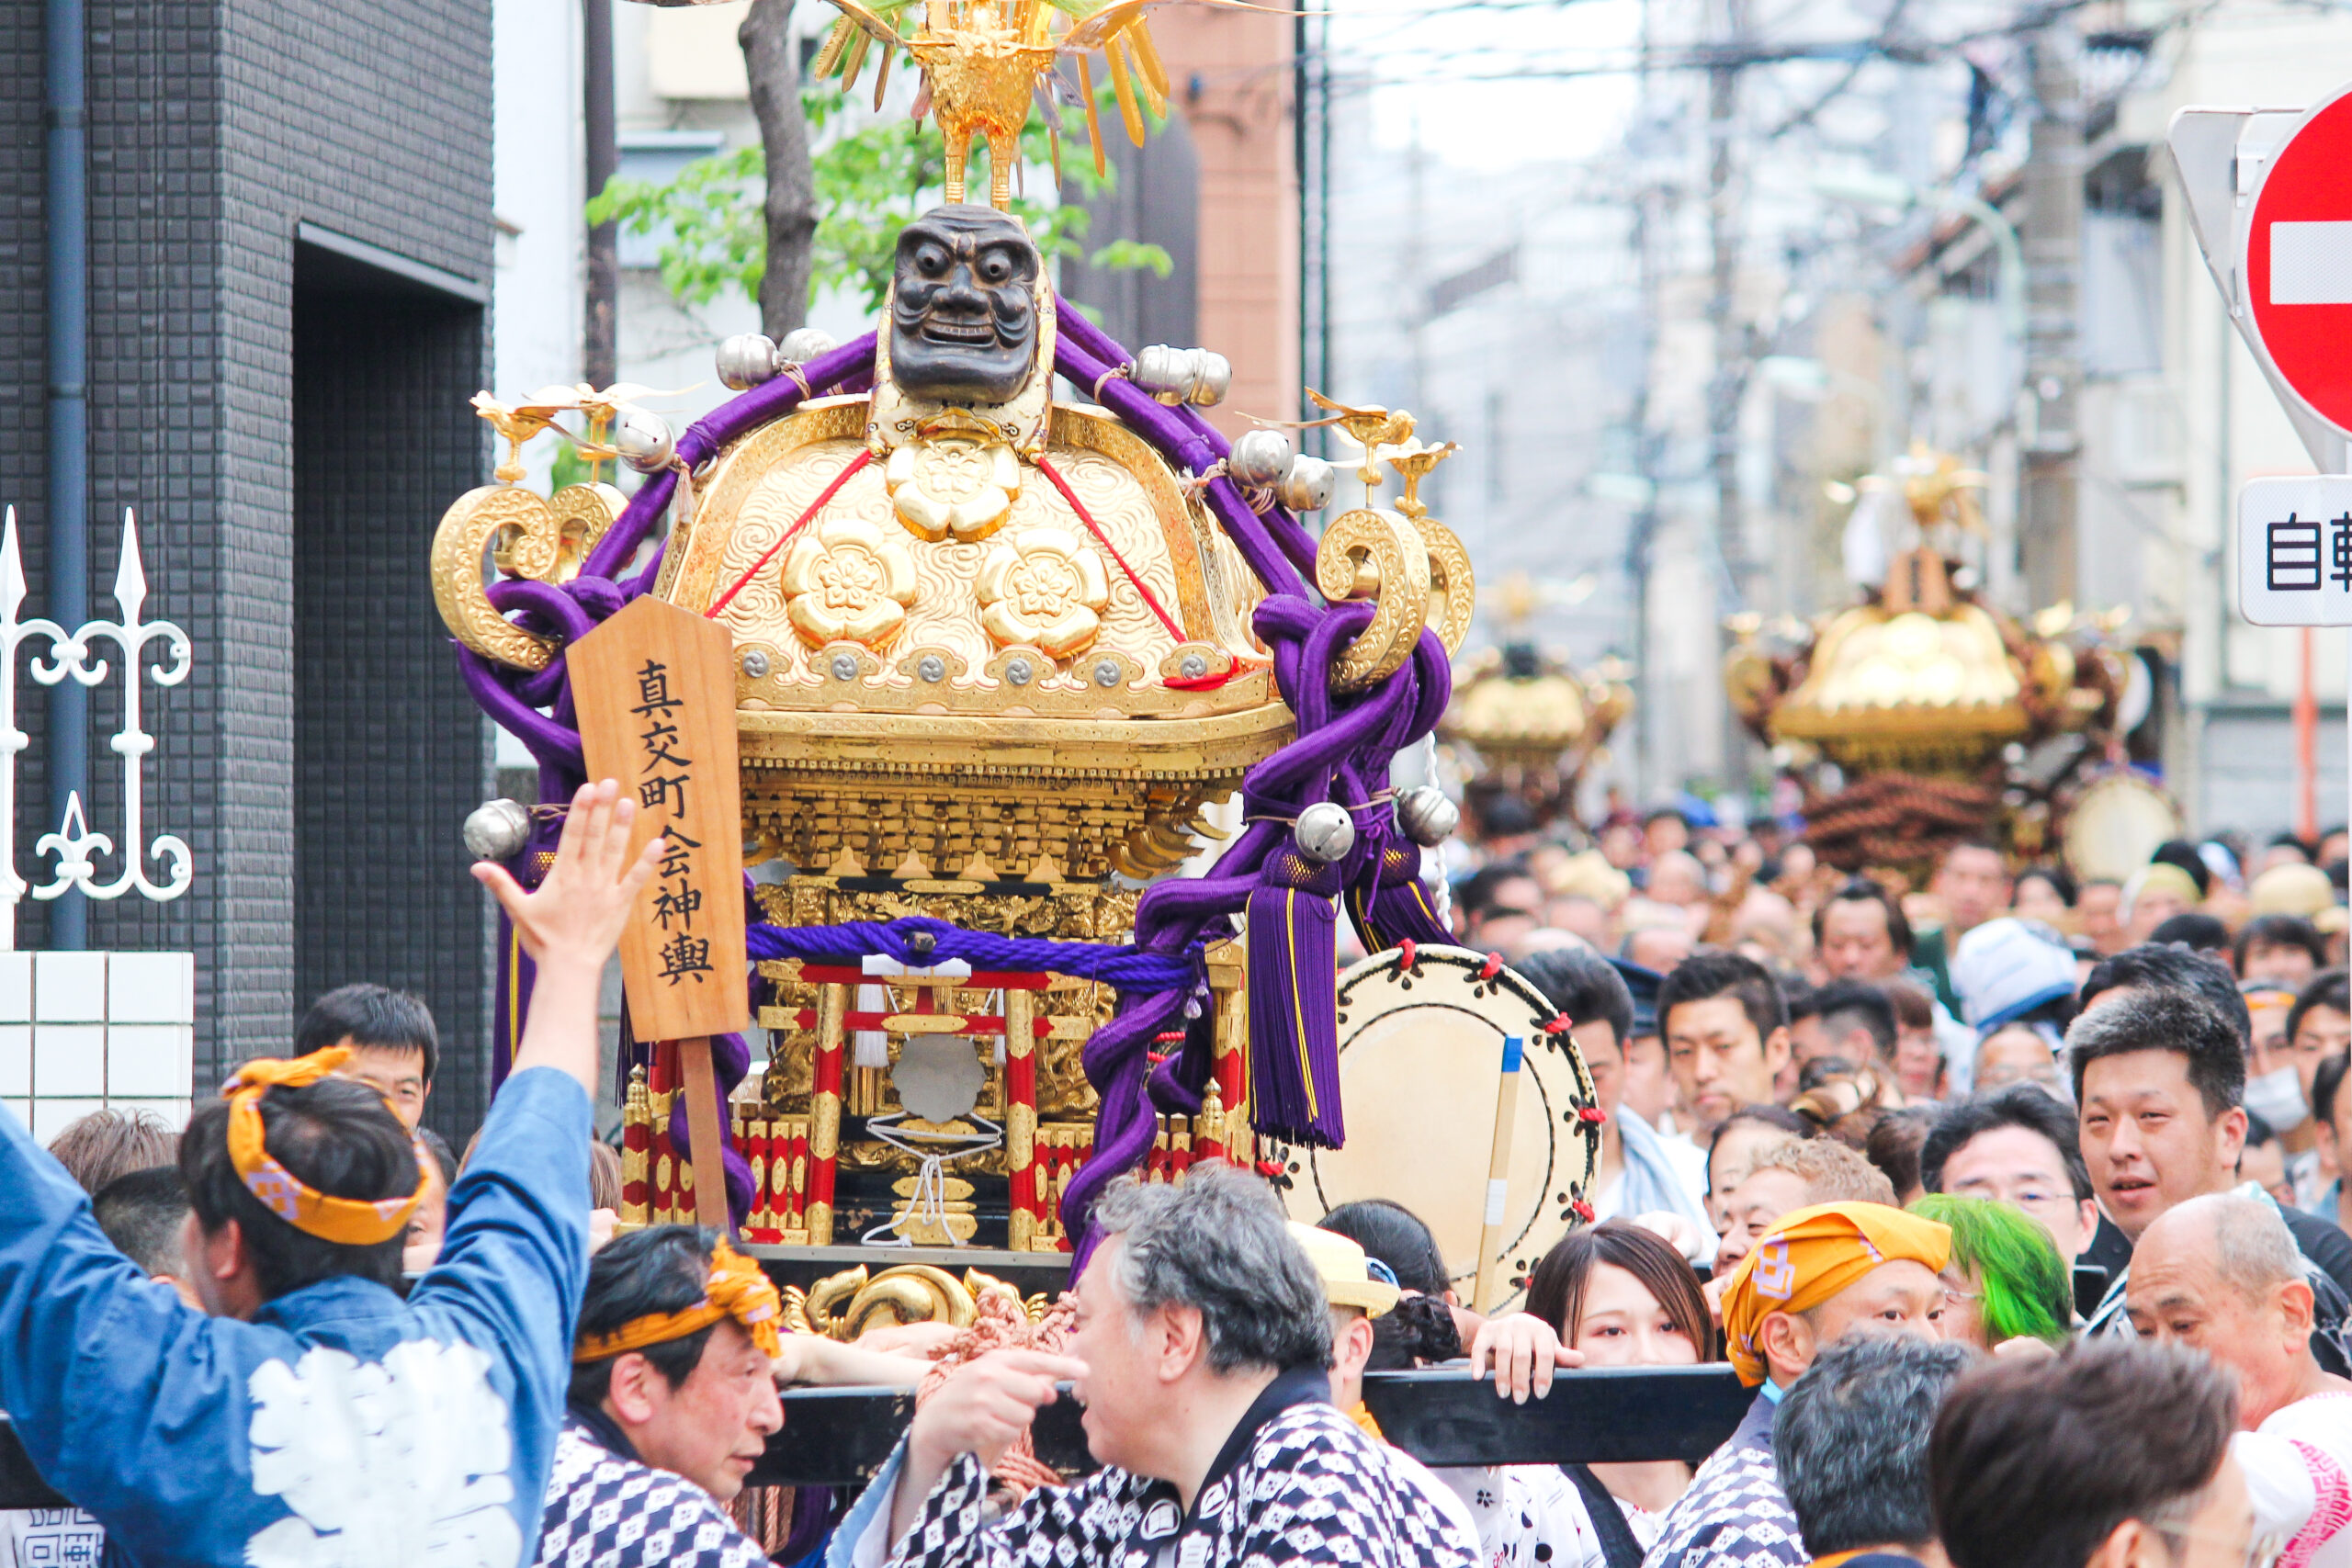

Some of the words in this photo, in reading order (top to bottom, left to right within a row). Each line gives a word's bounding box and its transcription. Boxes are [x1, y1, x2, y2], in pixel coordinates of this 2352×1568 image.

[629, 658, 715, 987] 真交町会神輿
